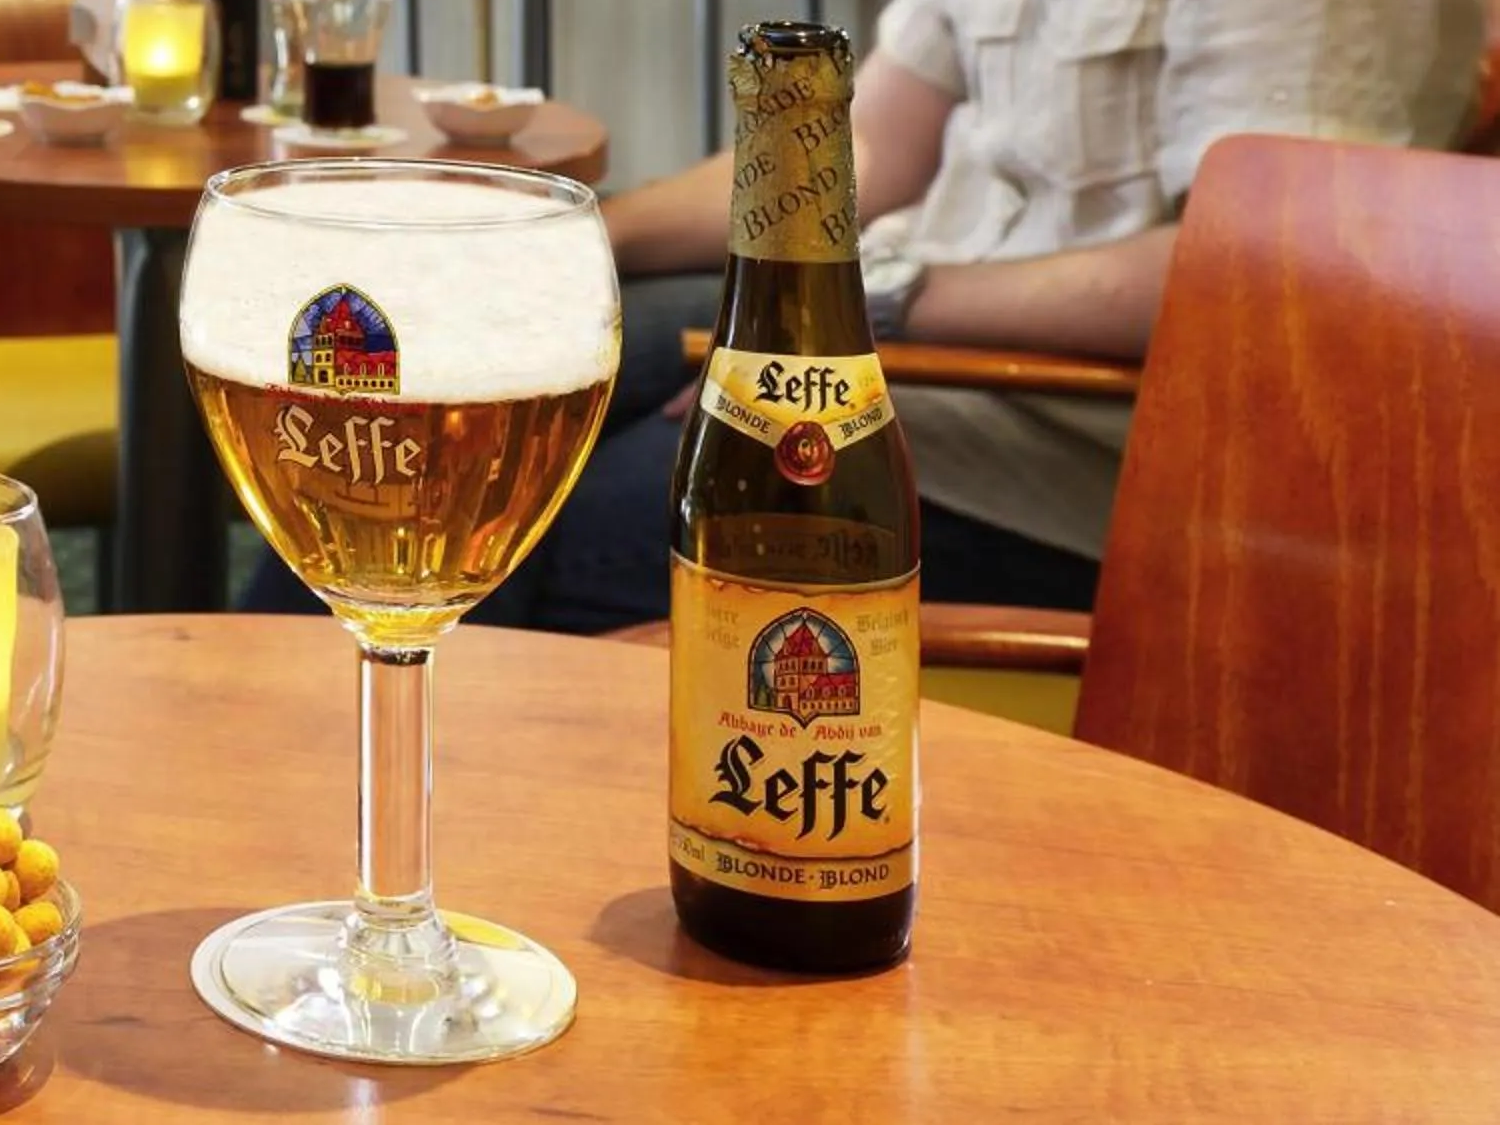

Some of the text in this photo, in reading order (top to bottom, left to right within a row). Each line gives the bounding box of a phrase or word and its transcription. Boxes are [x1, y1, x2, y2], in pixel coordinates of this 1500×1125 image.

[743, 166, 838, 242] BLOND
[754, 360, 850, 412] Leffe
[715, 395, 771, 434] BLONDE
[272, 404, 422, 485] Leffe
[779, 721, 797, 738] de
[708, 734, 890, 841] Leffe
[715, 851, 806, 885] BLONDE
[819, 863, 890, 890] BLOND
